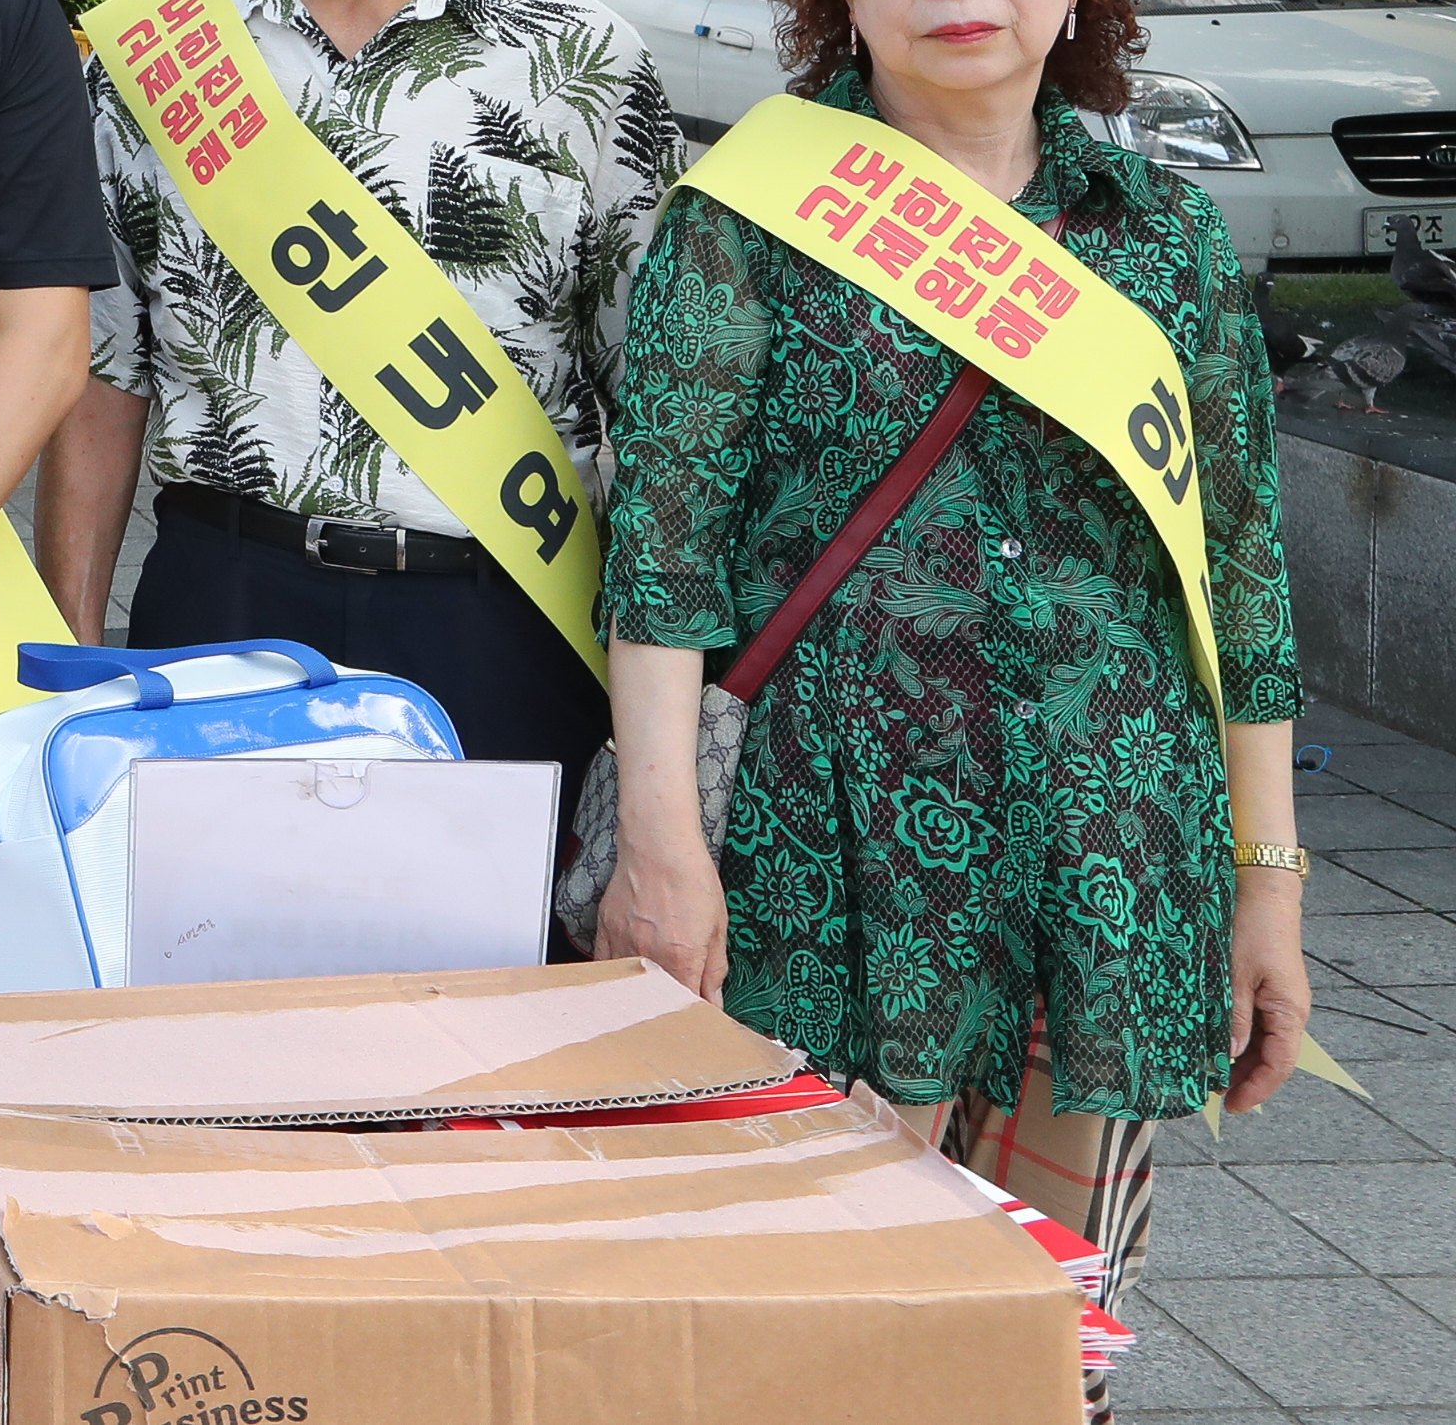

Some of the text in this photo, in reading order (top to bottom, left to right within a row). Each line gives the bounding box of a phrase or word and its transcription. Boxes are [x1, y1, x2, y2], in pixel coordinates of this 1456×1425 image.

[136, 22, 221, 107] 제한
[160, 63, 243, 144] 완전
[184, 103, 269, 185] 해결
[795, 142, 900, 242] 고도
[852, 177, 963, 281] 제한
[914, 214, 1022, 320] 완전
[974, 255, 1080, 360] 해결
[271, 199, 598, 600] 안내요
[120, 1352, 226, 1412] Print
